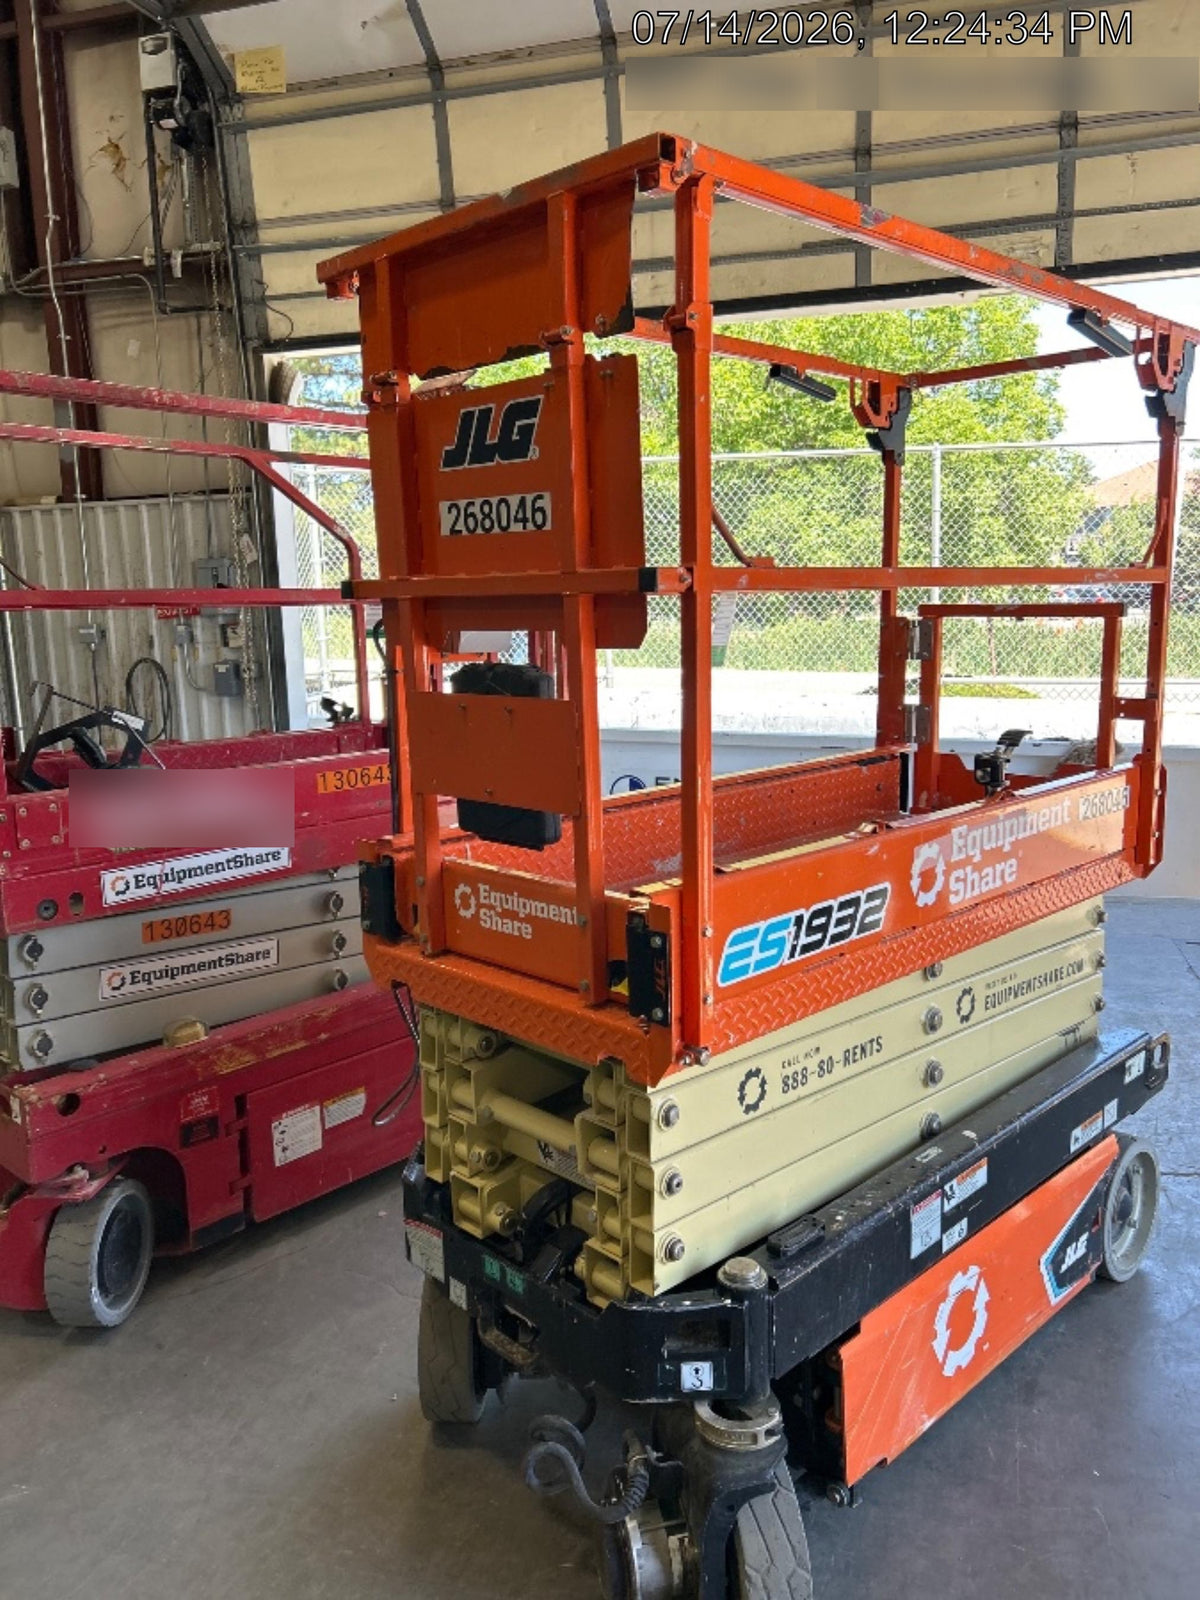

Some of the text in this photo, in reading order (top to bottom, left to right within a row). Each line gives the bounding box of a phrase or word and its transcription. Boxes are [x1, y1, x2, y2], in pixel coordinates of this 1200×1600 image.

[440, 395, 544, 471] JLG
[447, 494, 547, 535] 268046
[951, 799, 1072, 863] Equipment
[133, 850, 282, 889] EquipmentShare
[949, 858, 1018, 905] Share
[145, 910, 232, 941] 130643
[480, 908, 532, 939] Share
[718, 882, 891, 987] ES1932
[129, 949, 271, 985] EquipmentShare
[984, 958, 1084, 1011] EQUIPMENTSHARE.COM
[782, 1036, 882, 1094] 888-80-RENTS
